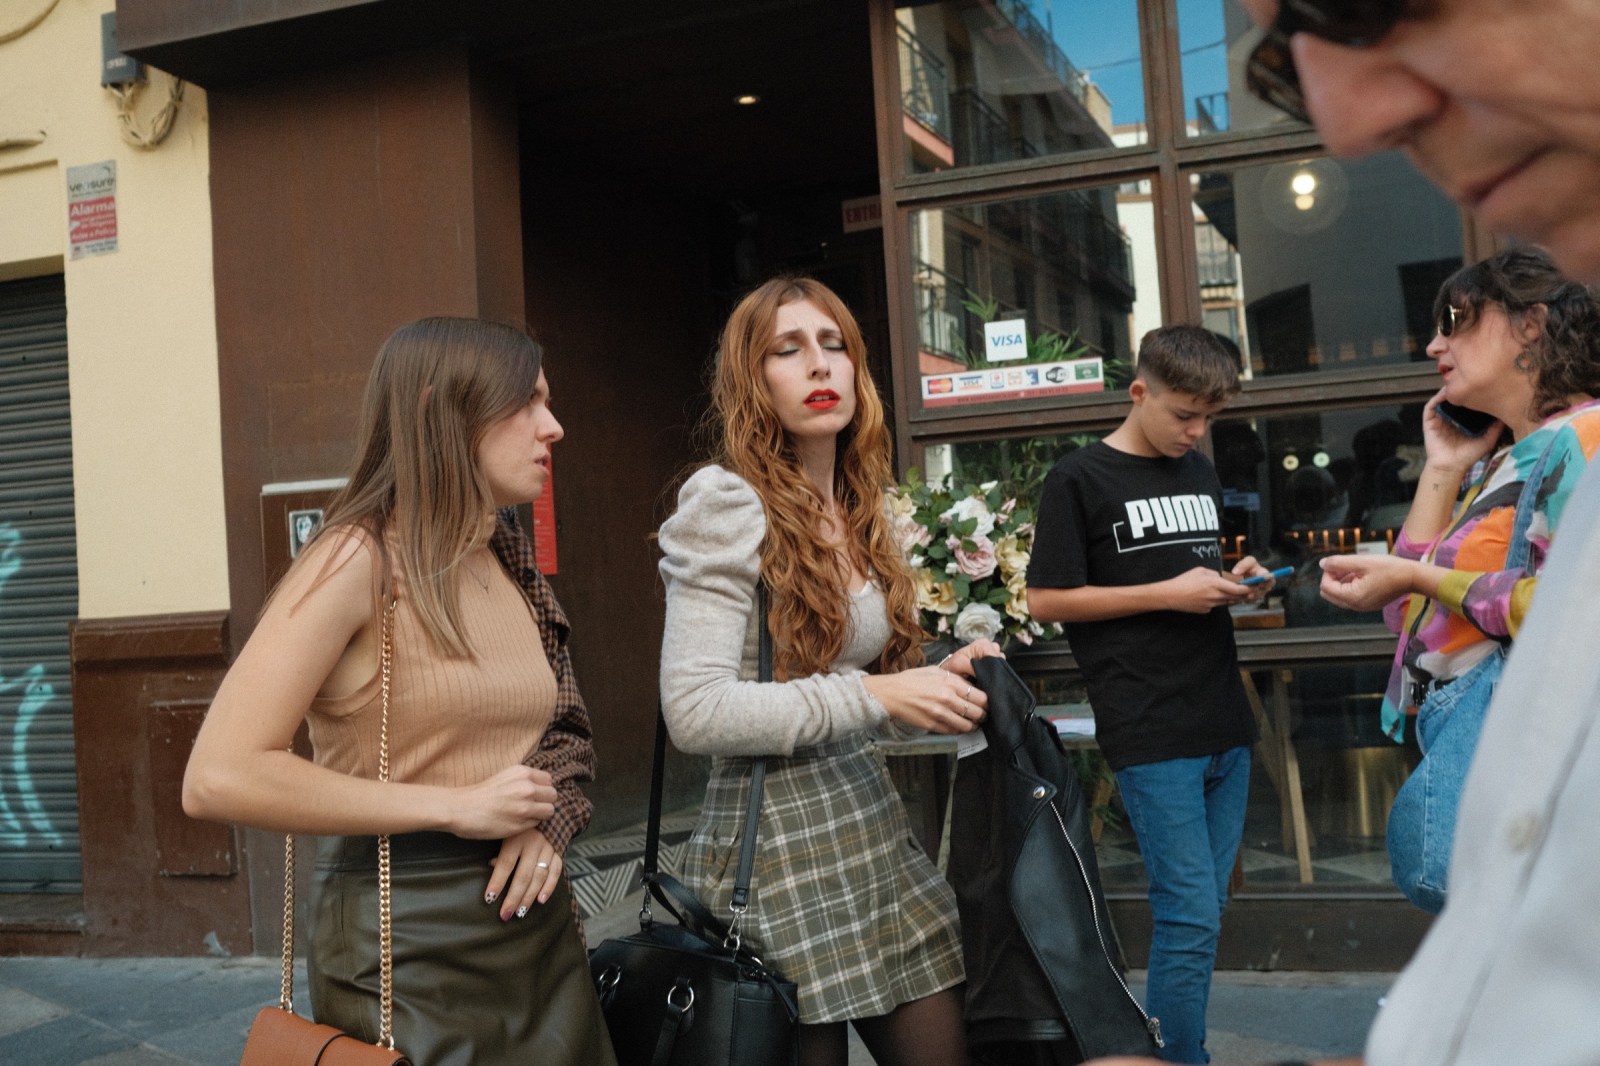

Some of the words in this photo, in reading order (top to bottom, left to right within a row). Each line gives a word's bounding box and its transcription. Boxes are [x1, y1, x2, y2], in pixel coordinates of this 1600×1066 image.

[69, 178, 114, 192] veisure
[71, 203, 115, 216] Alarma
[991, 334, 1023, 347] VISA
[1125, 494, 1219, 539] PUMA
